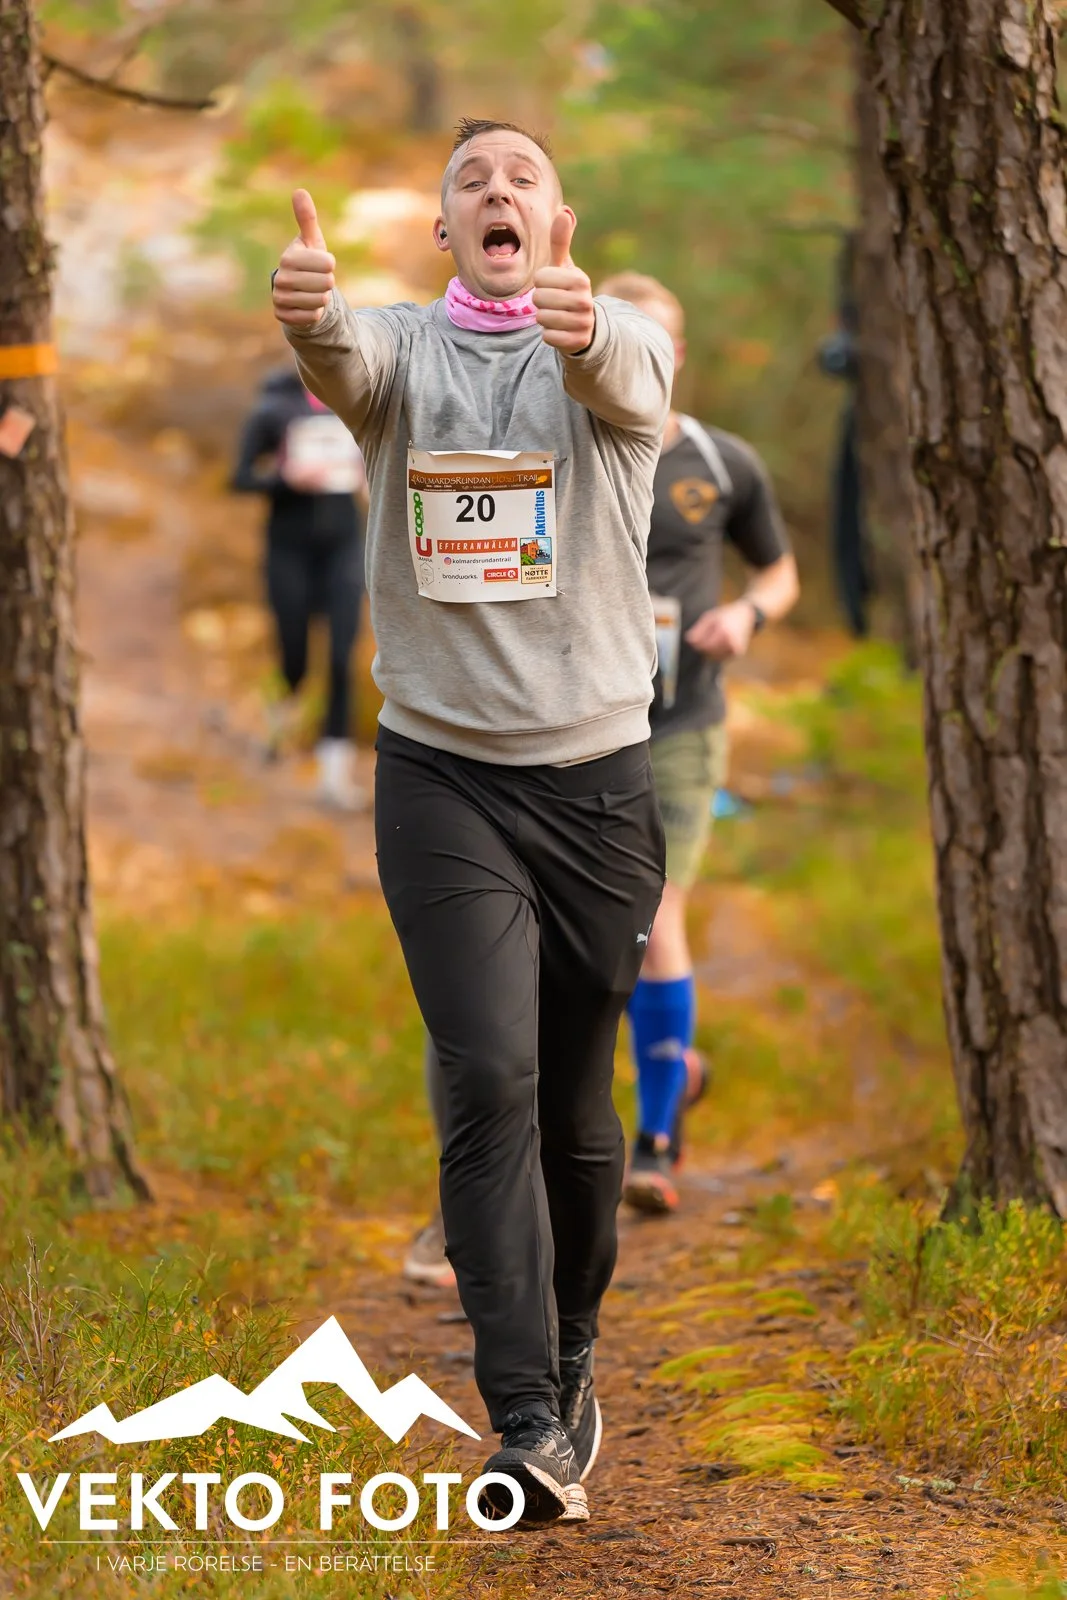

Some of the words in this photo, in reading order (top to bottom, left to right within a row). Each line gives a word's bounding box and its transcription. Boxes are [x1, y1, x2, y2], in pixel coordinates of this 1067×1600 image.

[413, 491, 424, 537] coop
[455, 494, 496, 523] 20
[534, 490, 546, 536] Aktivitus
[439, 539, 517, 551] EFTERANMÄLAN
[452, 556, 512, 564] kolmardsrundantrail
